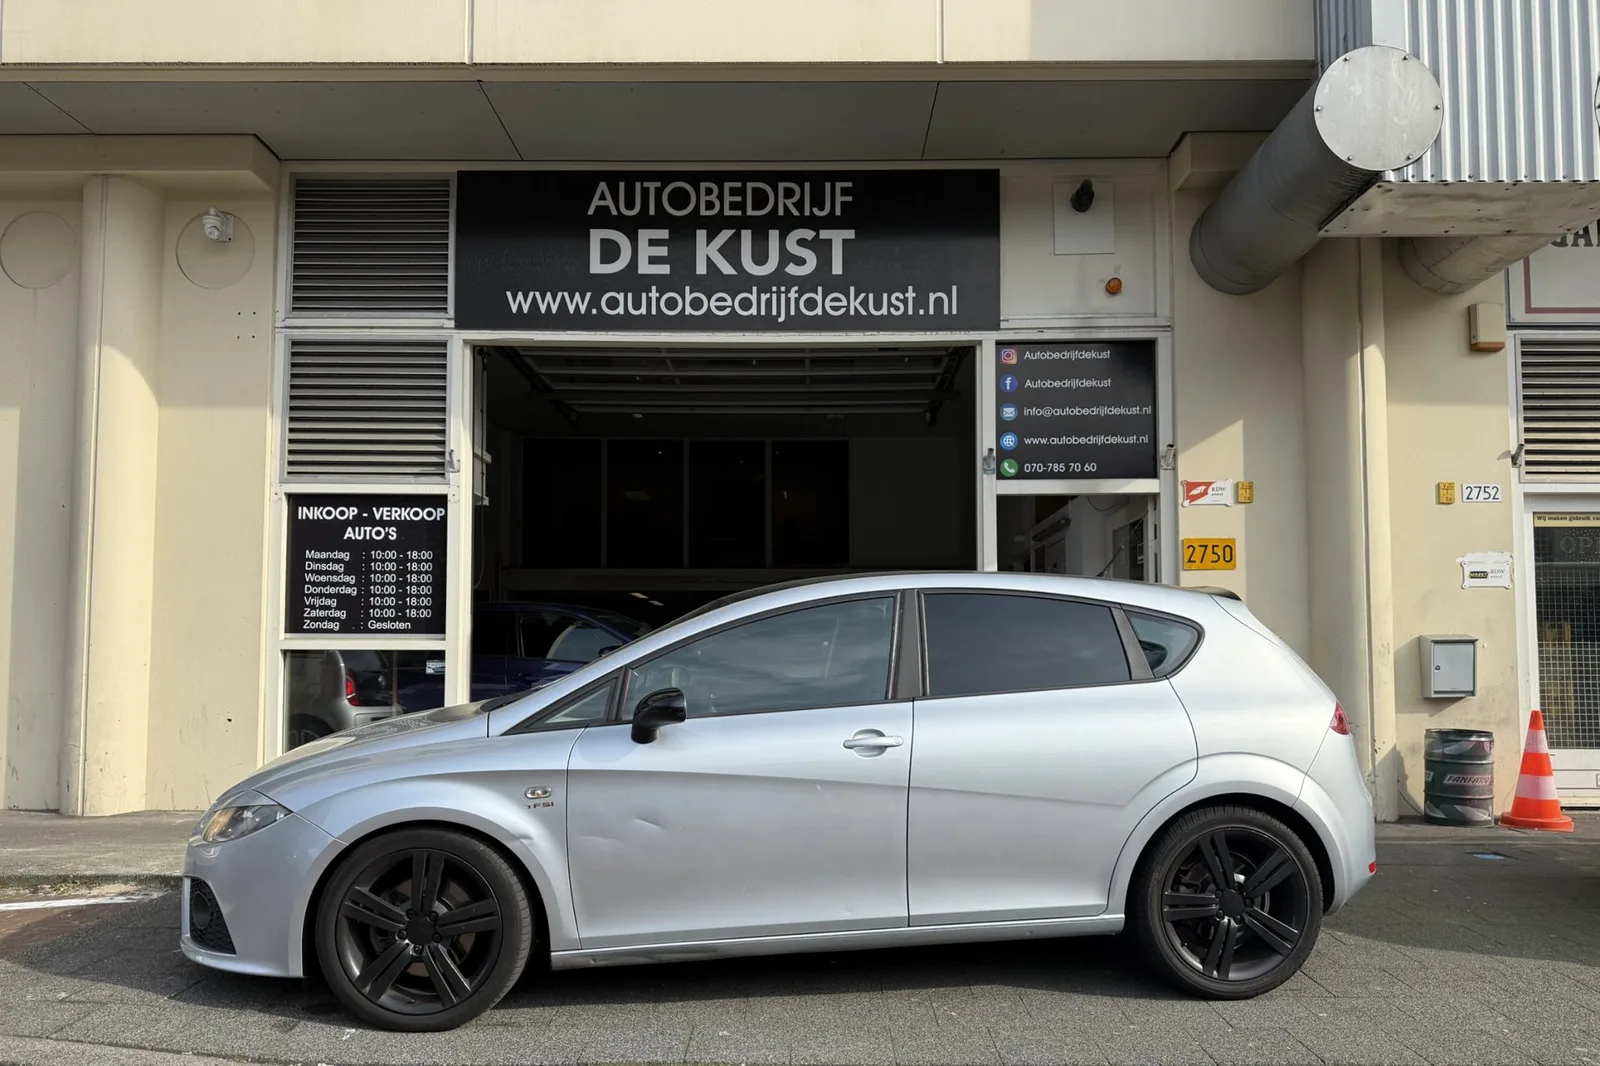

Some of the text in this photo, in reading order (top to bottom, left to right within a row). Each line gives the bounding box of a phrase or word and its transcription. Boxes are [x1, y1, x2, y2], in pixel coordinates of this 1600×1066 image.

[587, 181, 853, 216] AUTOBEDRIJF
[589, 229, 856, 276] DE KUST
[506, 285, 958, 323] www.autobedrijfdekust.nl
[1024, 350, 1110, 361] Autobedrijfdekust
[1024, 378, 1111, 389] Autobedrijfdekust
[1024, 406, 1151, 417] info@autobedrijfdekust.nl
[1024, 434, 1149, 446] www.autobedrijfdekust.nl
[1024, 463, 1097, 473] 070-785 70 60
[1466, 486, 1500, 500] 2752
[298, 506, 358, 520] INKOOP
[372, 507, 445, 521] VERKOOP
[343, 527, 397, 540] AUTO'S
[305, 550, 350, 561] Maandag
[370, 551, 397, 559] 10:00
[406, 551, 433, 560] 18:00
[1186, 544, 1233, 564] 2750
[305, 562, 344, 572] Dinsdag
[370, 562, 396, 571] 10:00
[406, 563, 433, 571] 18:00
[305, 574, 356, 584] Woensdag
[370, 574, 396, 583] 10:00
[406, 574, 432, 583] 18:00
[304, 585, 357, 596] Donderdag
[369, 586, 396, 594] 10:00
[406, 586, 432, 595] 18:00
[304, 597, 337, 607] Vrijdag
[369, 597, 396, 606] 10:00
[405, 598, 432, 606] 18:00
[303, 608, 346, 619] Zaterdag
[369, 609, 395, 617] 10:00
[405, 609, 432, 618] 18:00
[303, 620, 340, 631] Zondag
[368, 620, 411, 630] Gesloten
[1446, 775, 1489, 785] FANFARO
